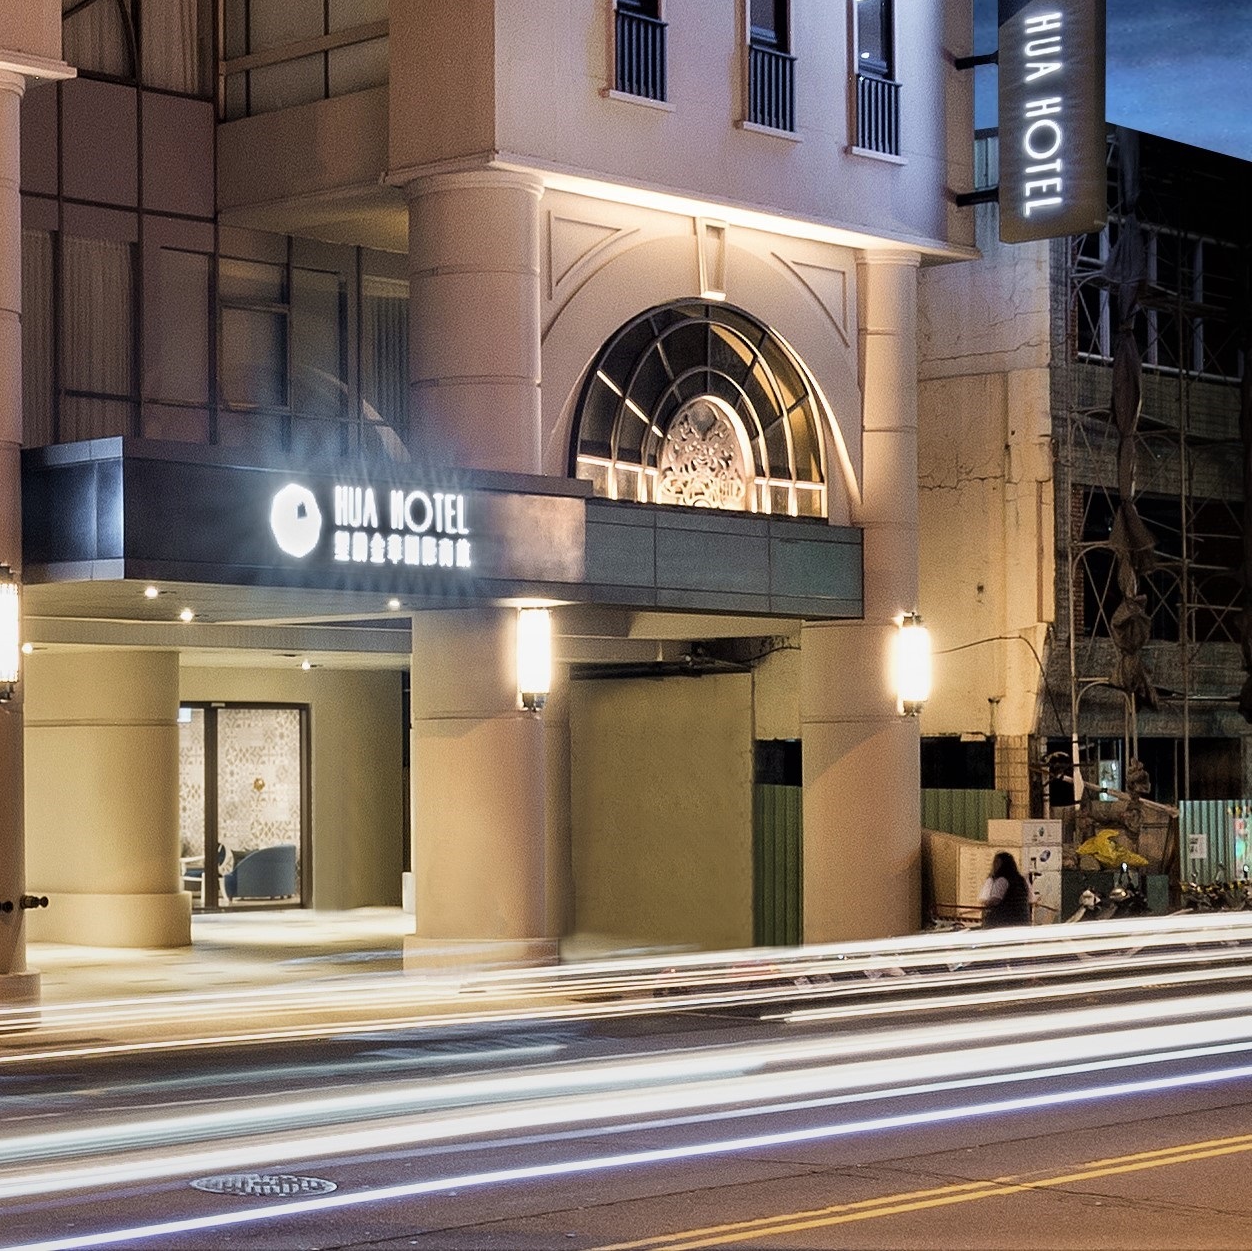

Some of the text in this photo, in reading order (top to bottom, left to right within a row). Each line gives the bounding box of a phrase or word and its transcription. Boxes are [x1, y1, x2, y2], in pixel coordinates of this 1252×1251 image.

[1023, 11, 1064, 218] HUA HOTEL
[333, 484, 471, 536] HUA HOTEL
